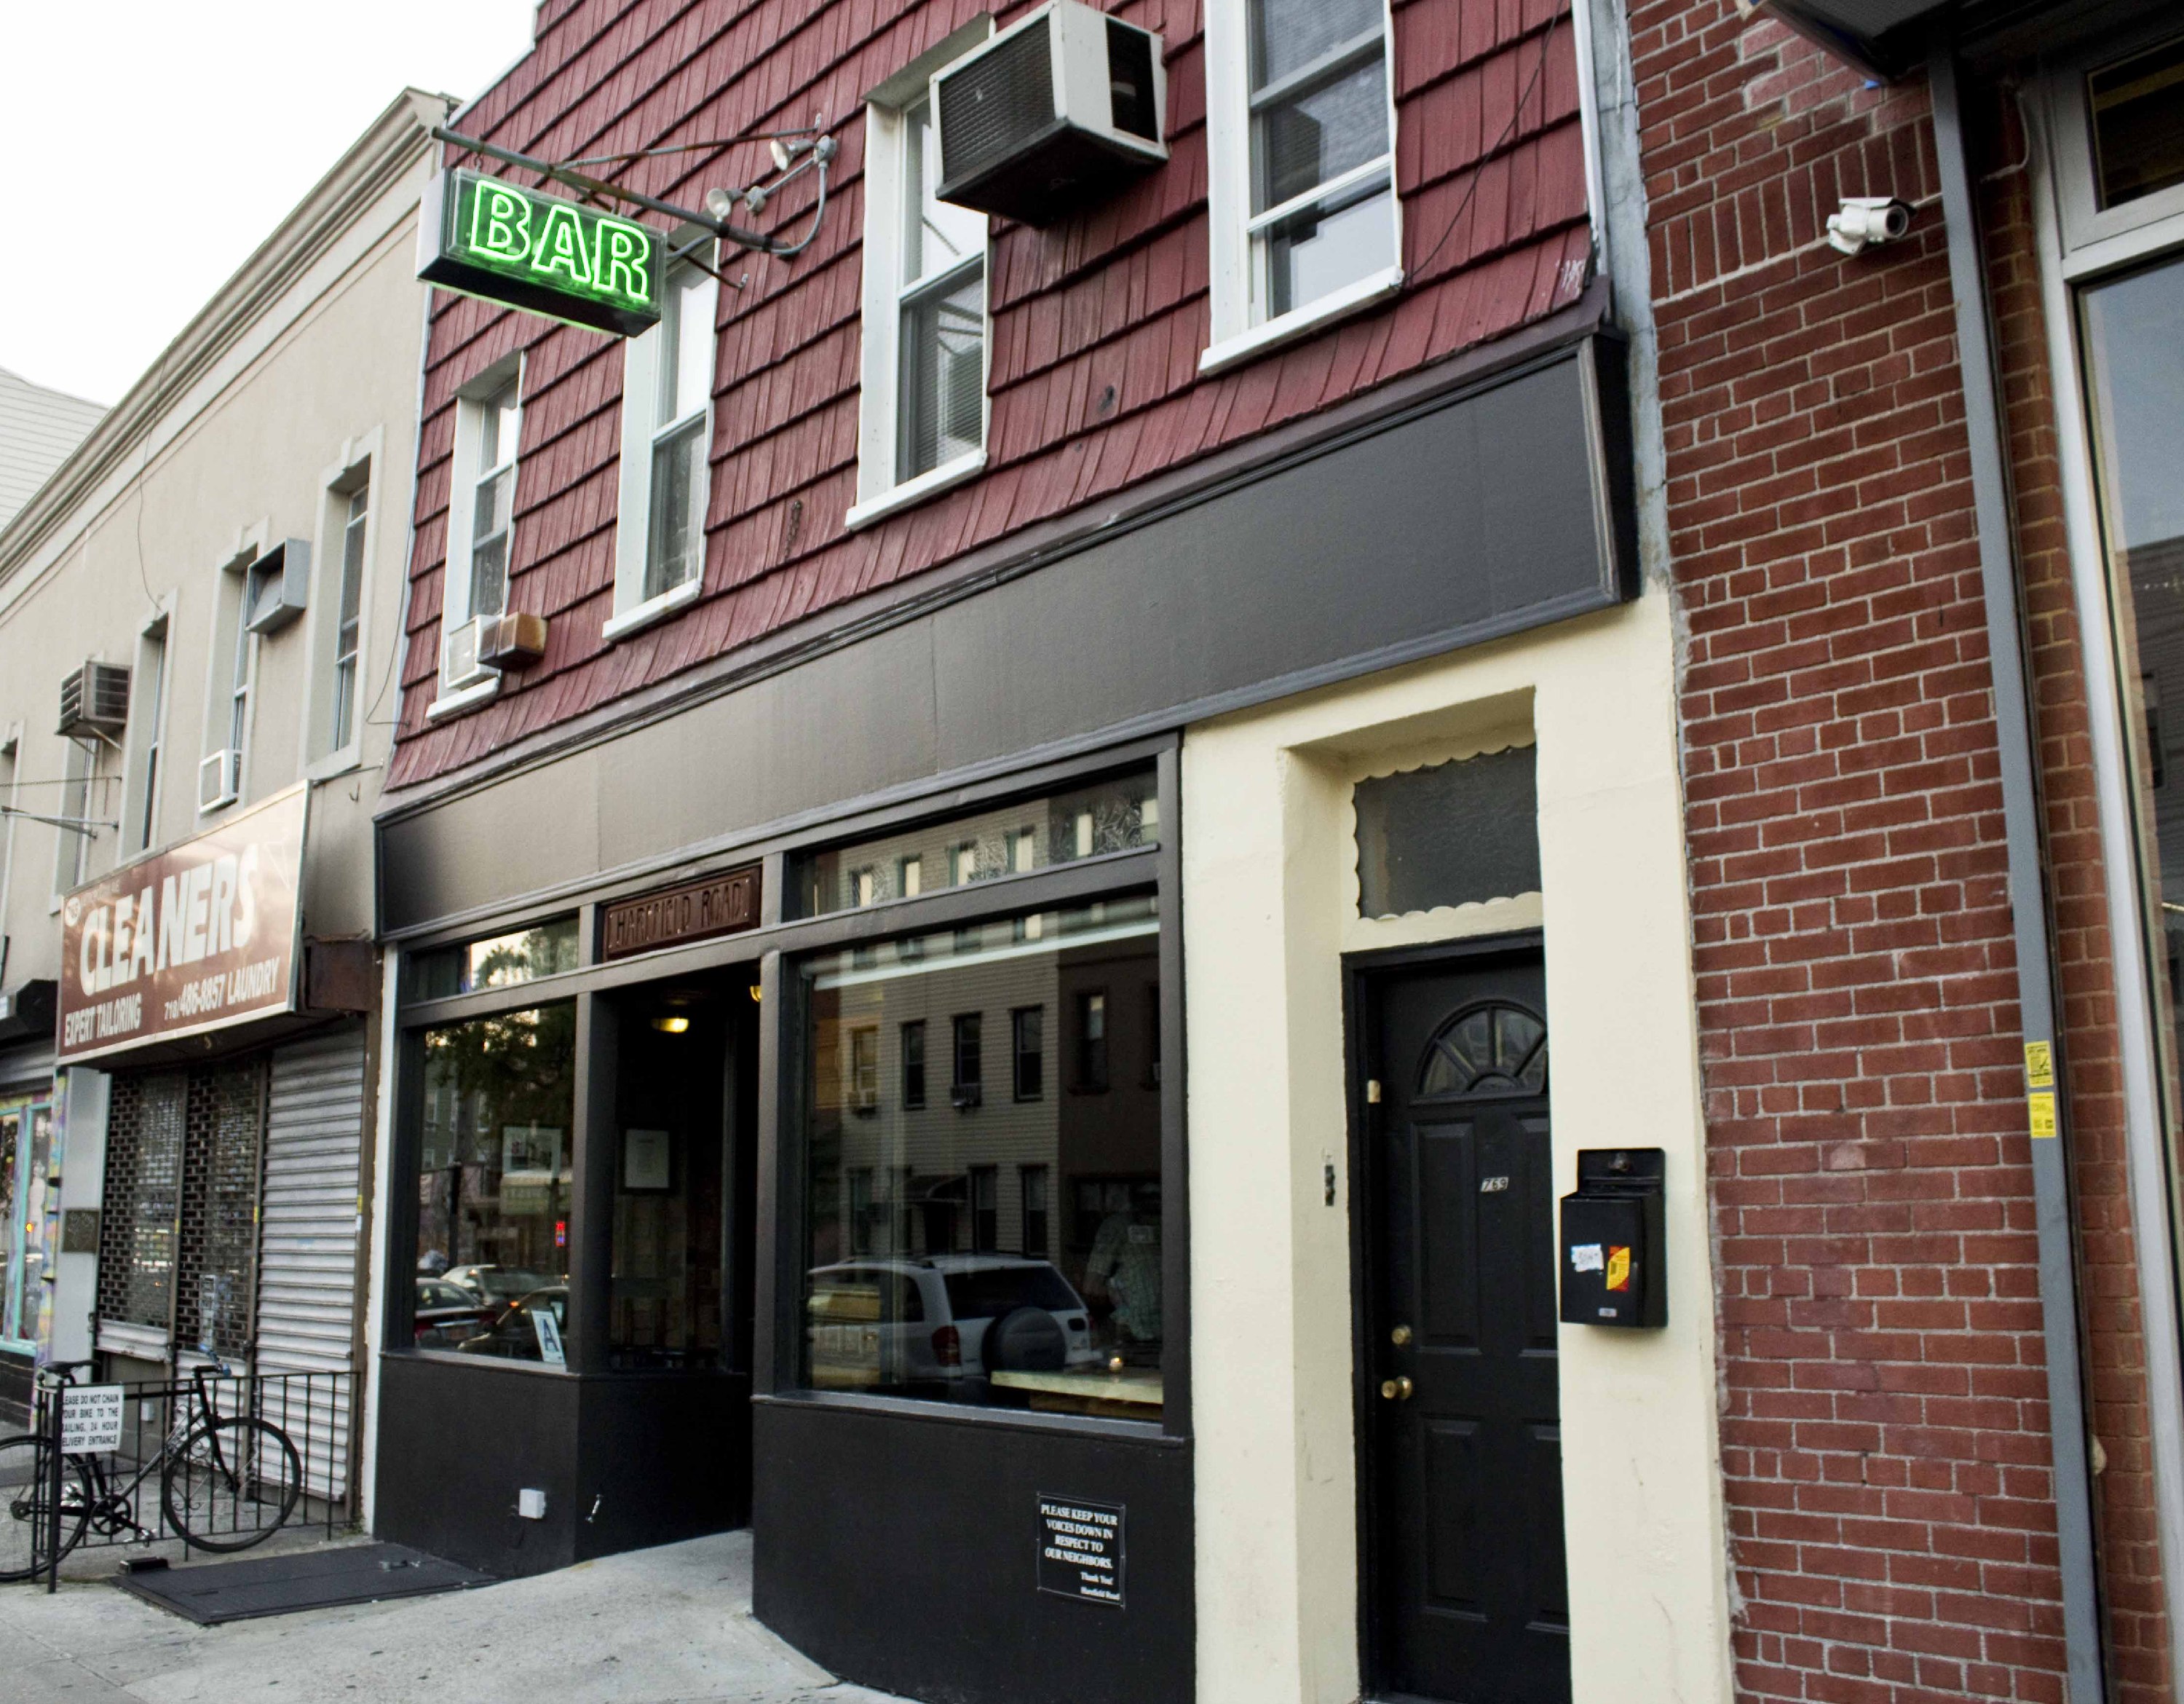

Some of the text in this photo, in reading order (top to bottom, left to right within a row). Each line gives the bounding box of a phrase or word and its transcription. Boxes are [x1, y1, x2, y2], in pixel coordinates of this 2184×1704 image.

[470, 178, 650, 302] BAR
[79, 843, 259, 997] CLEANERS
[226, 955, 280, 1006] LAUNDRY
[64, 992, 142, 1047] EXPERT TAILORING
[541, 1317, 560, 1352] A
[63, 1395, 79, 1405] EASE
[81, 1395, 88, 1404] DO
[90, 1394, 101, 1404] NOT
[63, 1408, 76, 1419] OUR
[97, 1408, 103, 1417] TO
[61, 1435, 86, 1447] ELIVERY
[1040, 1504, 1118, 1526] PLEASE KEEP YOUR
[1046, 1518, 1113, 1539] VOICES DOWN IN
[1045, 1547, 1062, 1560] OUR
[1055, 1534, 1104, 1553] RESPECT TO
